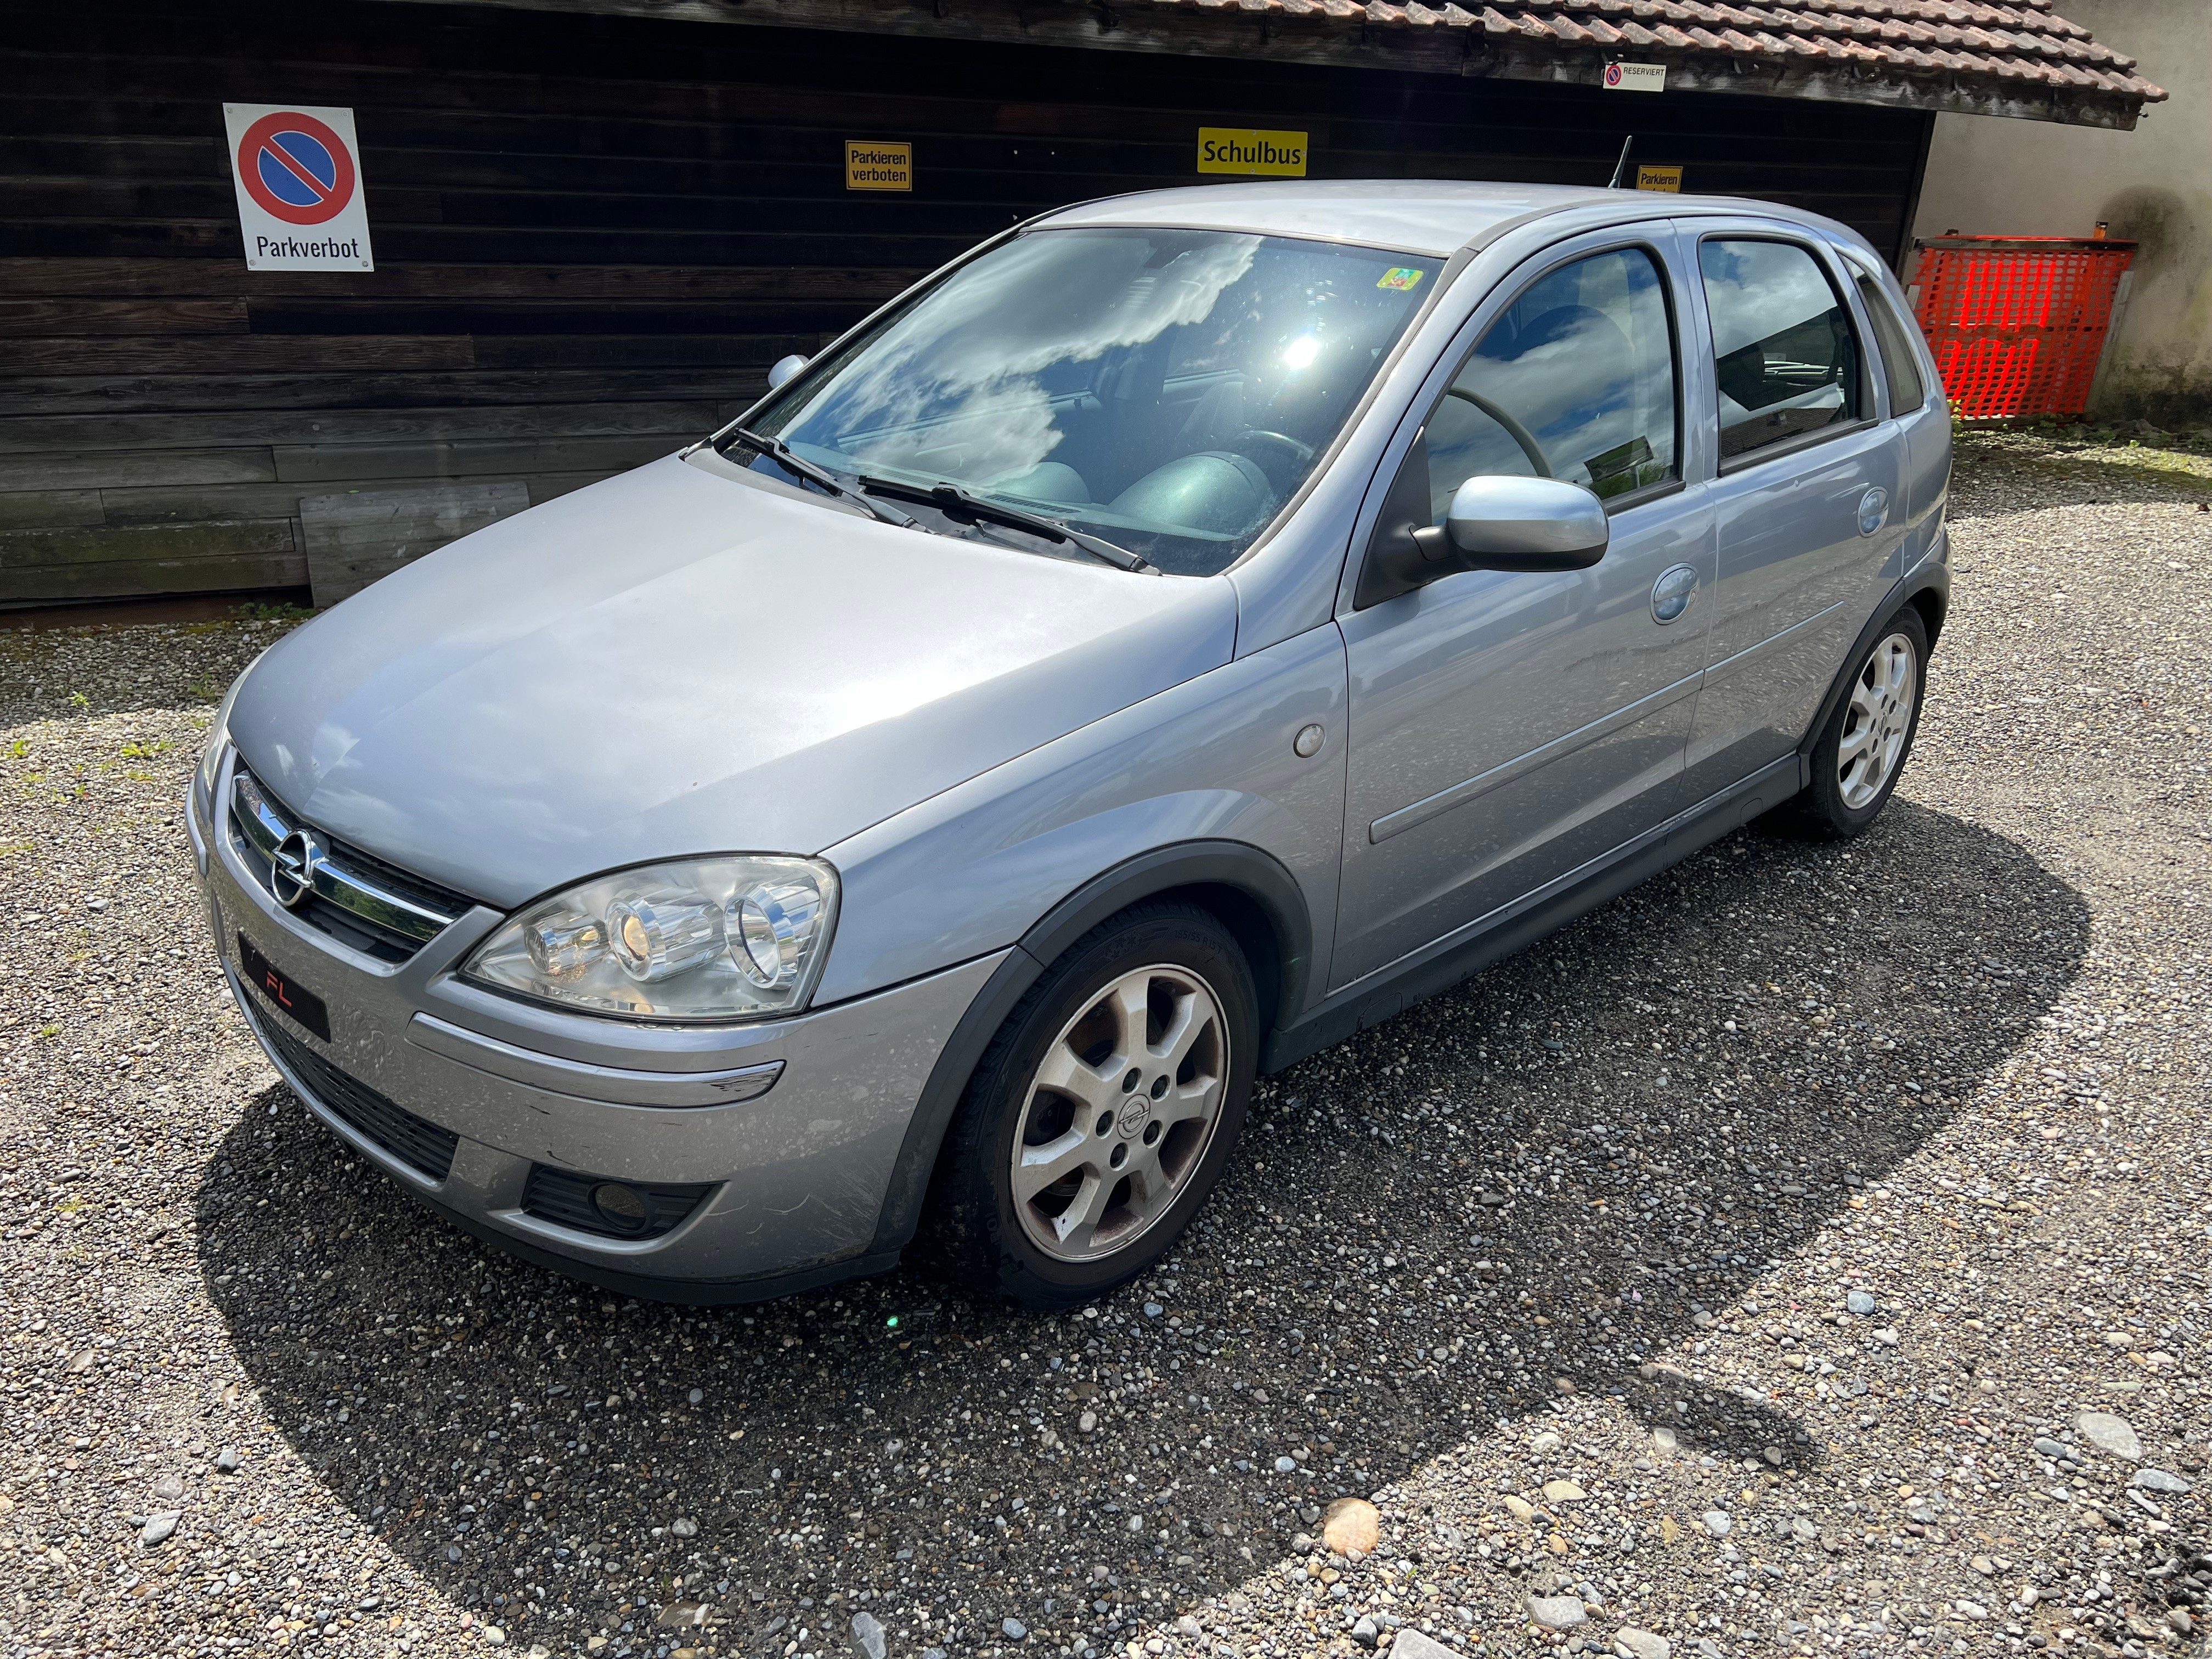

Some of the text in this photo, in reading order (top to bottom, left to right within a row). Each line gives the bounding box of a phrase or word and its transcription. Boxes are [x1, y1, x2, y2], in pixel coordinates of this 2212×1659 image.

[1624, 66, 1664, 76] RESERVIERT
[851, 150, 906, 165] Parkieren
[1204, 140, 1301, 165] Schulbus
[852, 168, 906, 182] verboten
[1641, 173, 1678, 185] Parkieren
[257, 236, 359, 258] Parkverbot
[1175, 929, 1200, 943] 185/55
[267, 970, 292, 1007] FL
